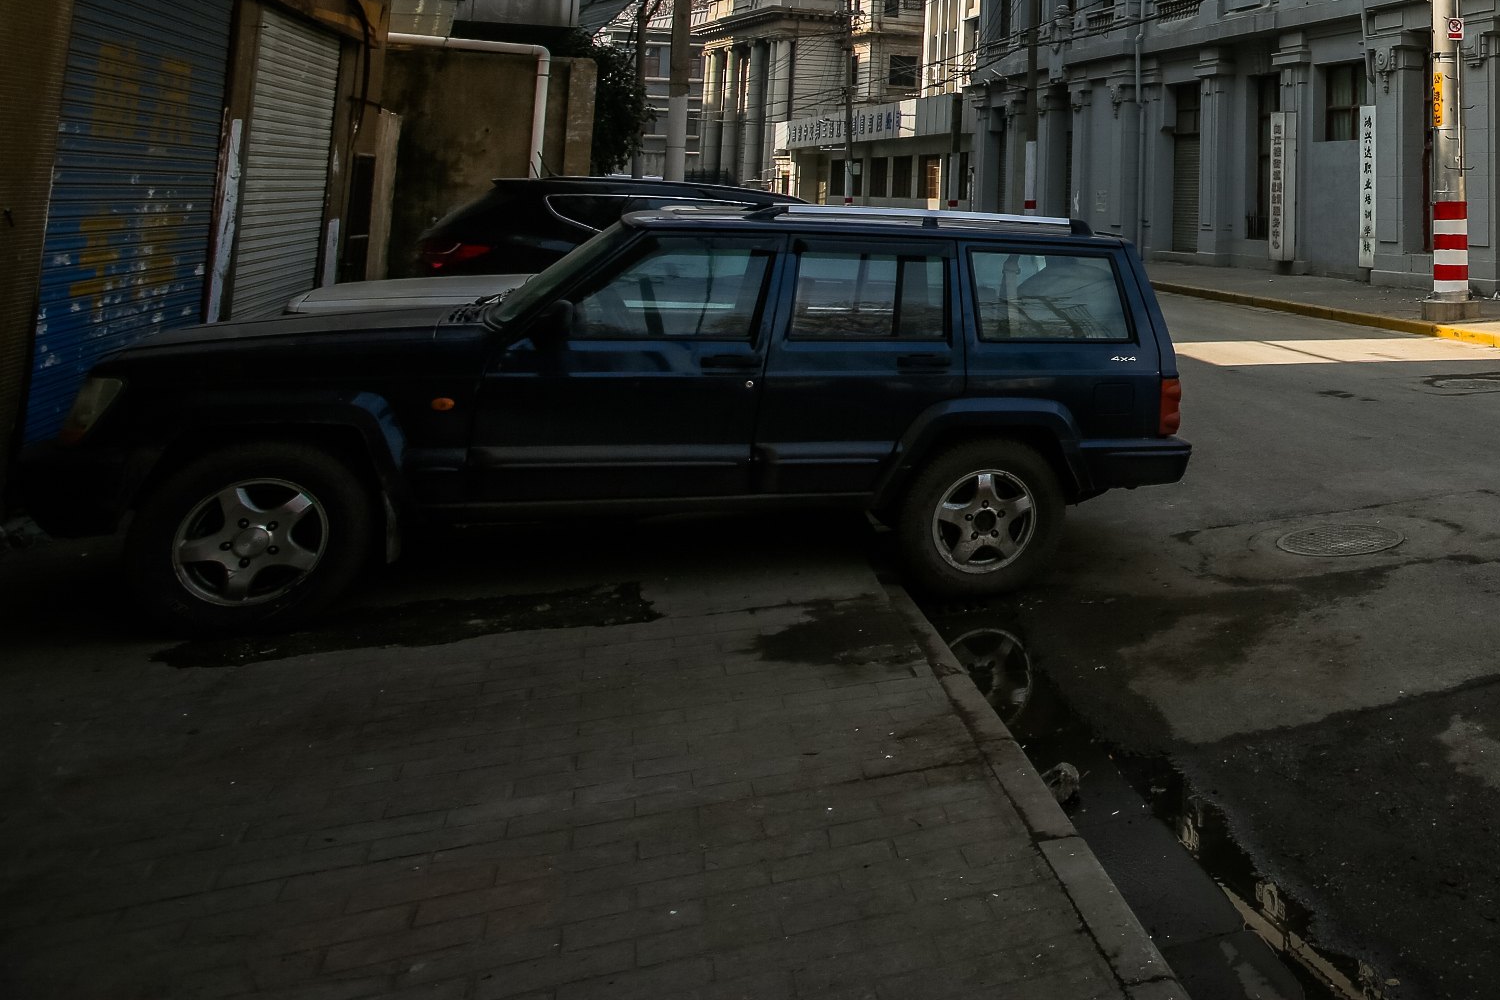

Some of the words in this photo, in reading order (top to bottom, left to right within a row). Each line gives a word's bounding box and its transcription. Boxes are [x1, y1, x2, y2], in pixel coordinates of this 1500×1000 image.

[1363, 116, 1373, 253] 鸿兴达职业培训学校
